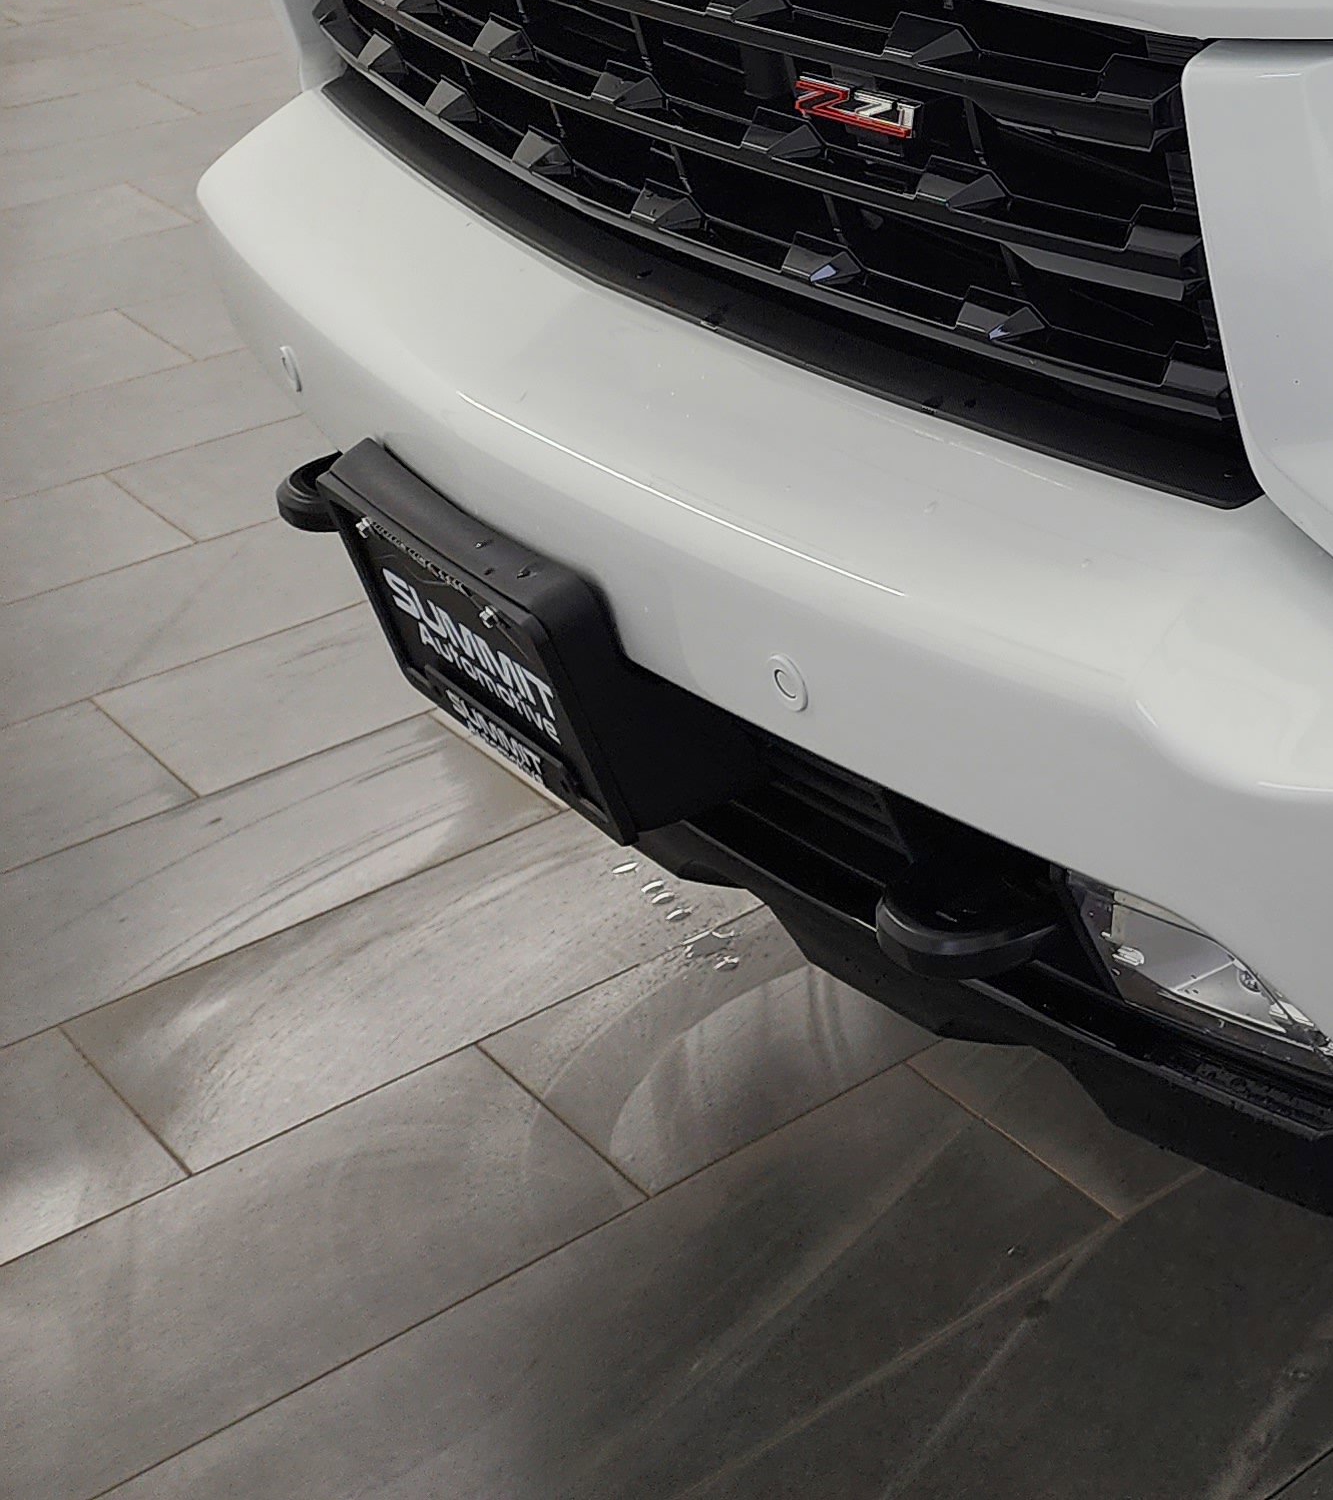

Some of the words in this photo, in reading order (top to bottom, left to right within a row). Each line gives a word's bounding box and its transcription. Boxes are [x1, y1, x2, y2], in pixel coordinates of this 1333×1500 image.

[794, 75, 917, 140] Z71
[382, 567, 555, 722] SUMMIT
[418, 620, 562, 746] Automotive
[445, 688, 543, 776] SUMMIT
